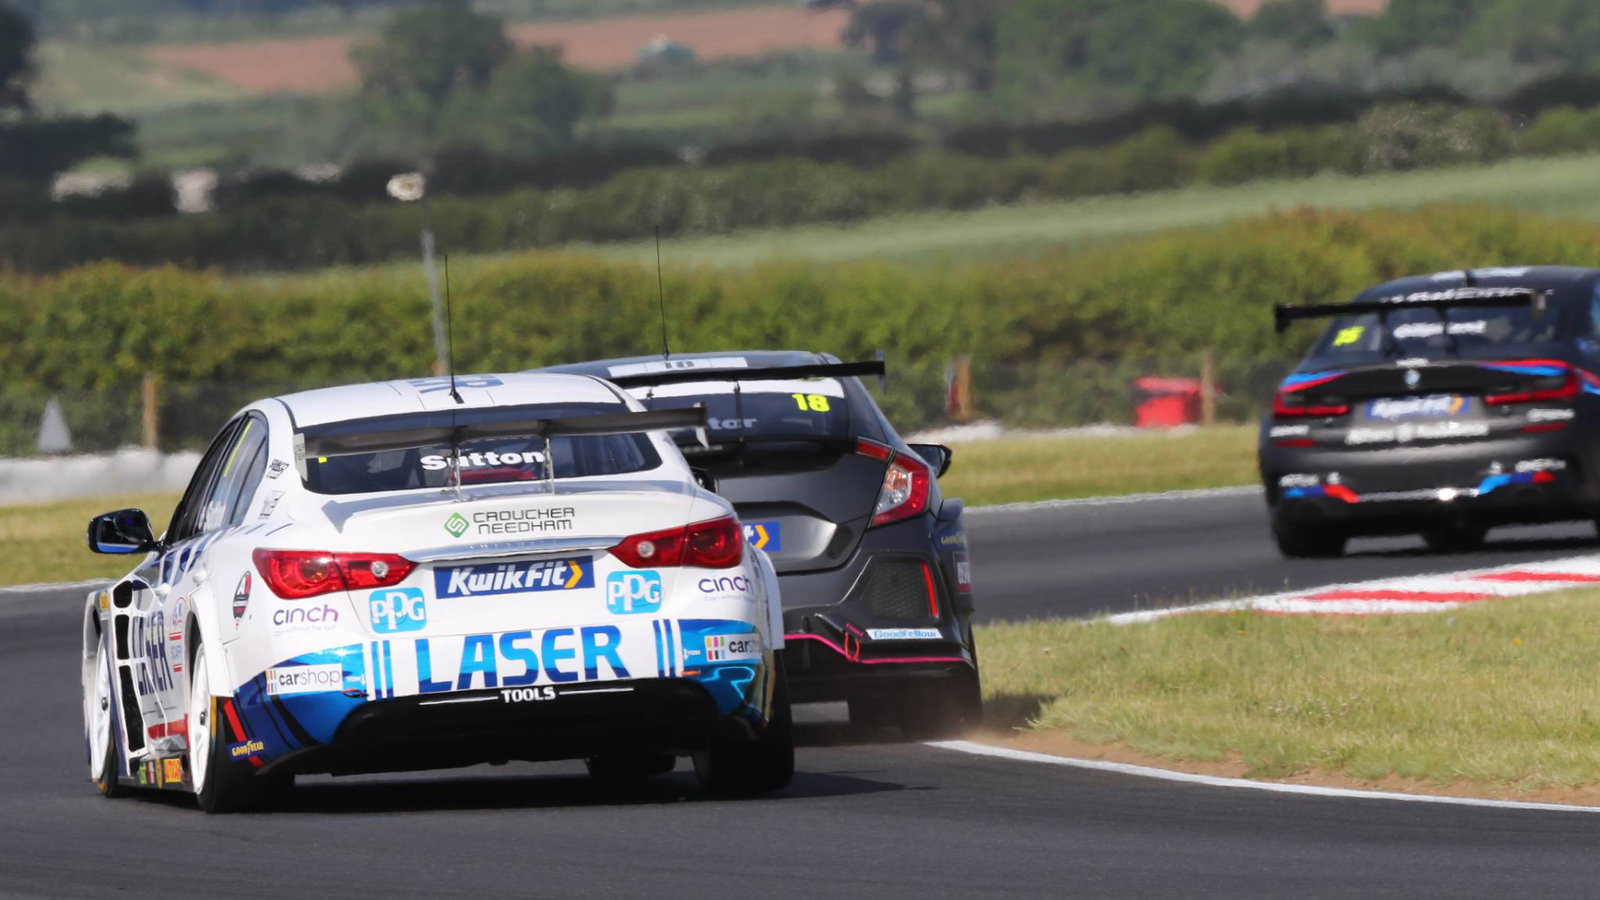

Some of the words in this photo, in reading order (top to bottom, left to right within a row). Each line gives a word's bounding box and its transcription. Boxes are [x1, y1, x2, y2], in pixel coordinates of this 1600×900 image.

[792, 393, 830, 412] 18
[420, 450, 545, 471] Sutton
[473, 507, 575, 523] CROUCHER
[478, 519, 573, 535] NEEDHAM
[447, 560, 568, 596] KwikFit
[698, 574, 755, 595] cinch
[608, 574, 661, 612] PPG
[273, 604, 339, 626] cinch
[370, 592, 426, 630] PPG
[414, 624, 632, 695] LASER
[279, 667, 341, 687] carshop
[501, 686, 556, 704] TOOLS
